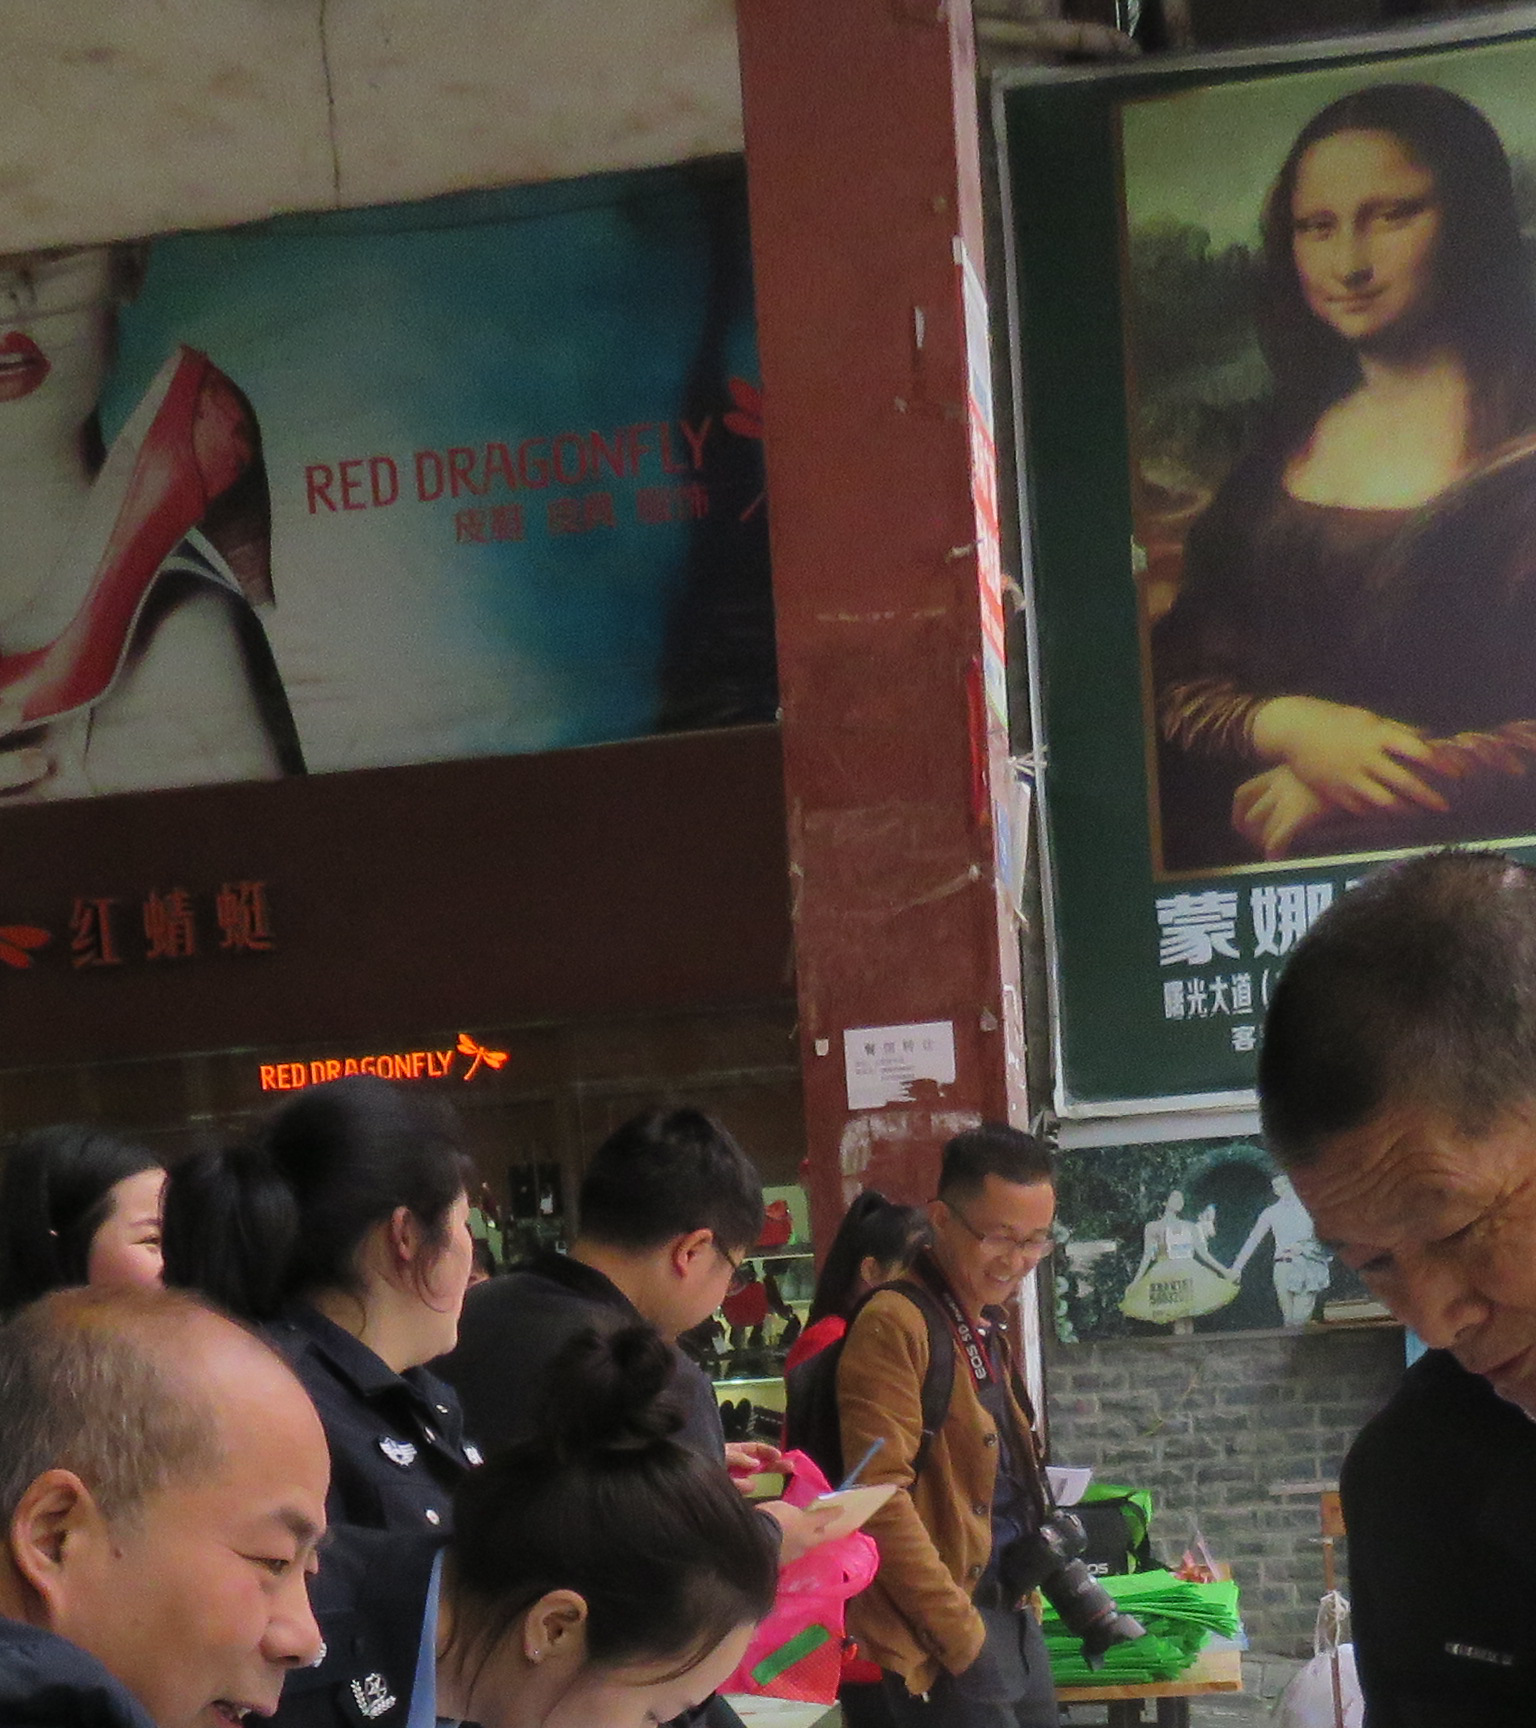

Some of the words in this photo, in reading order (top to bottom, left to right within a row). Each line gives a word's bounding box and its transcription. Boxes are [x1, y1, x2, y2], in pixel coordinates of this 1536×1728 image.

[305, 457, 399, 515] RED
[413, 417, 711, 502] DRAGONFLY
[71, 881, 276, 969] 红蜻蜓
[260, 1062, 307, 1091] RED
[309, 1050, 456, 1085] DRAGONFLY
[965, 1343, 987, 1380] EOS
